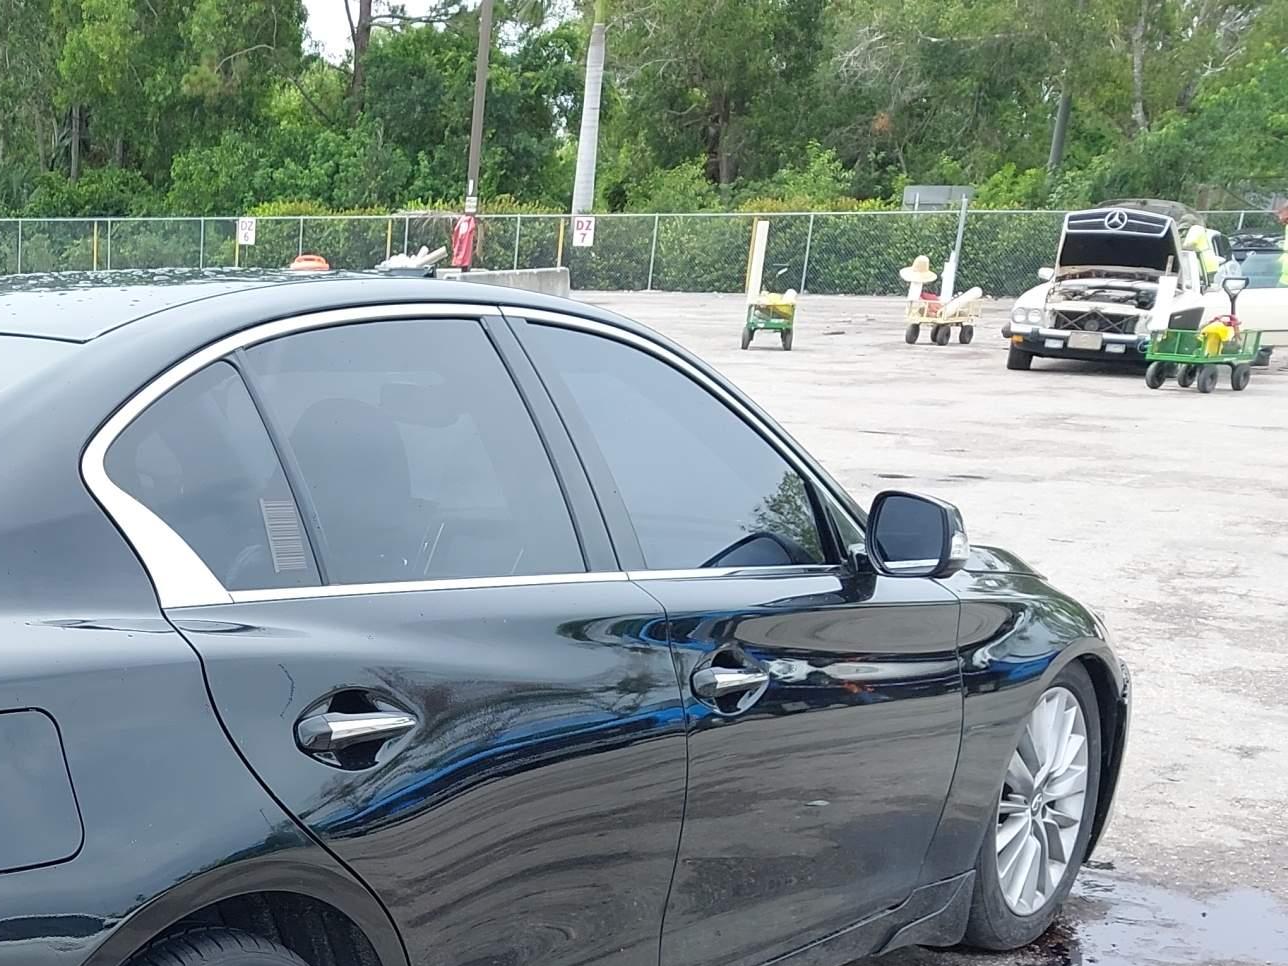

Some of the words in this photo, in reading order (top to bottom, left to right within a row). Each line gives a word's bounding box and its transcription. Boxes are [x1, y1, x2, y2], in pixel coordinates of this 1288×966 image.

[241, 220, 254, 231] DZ
[576, 220, 593, 231] DZ
[243, 231, 249, 241] 6
[579, 232, 587, 243] 7
